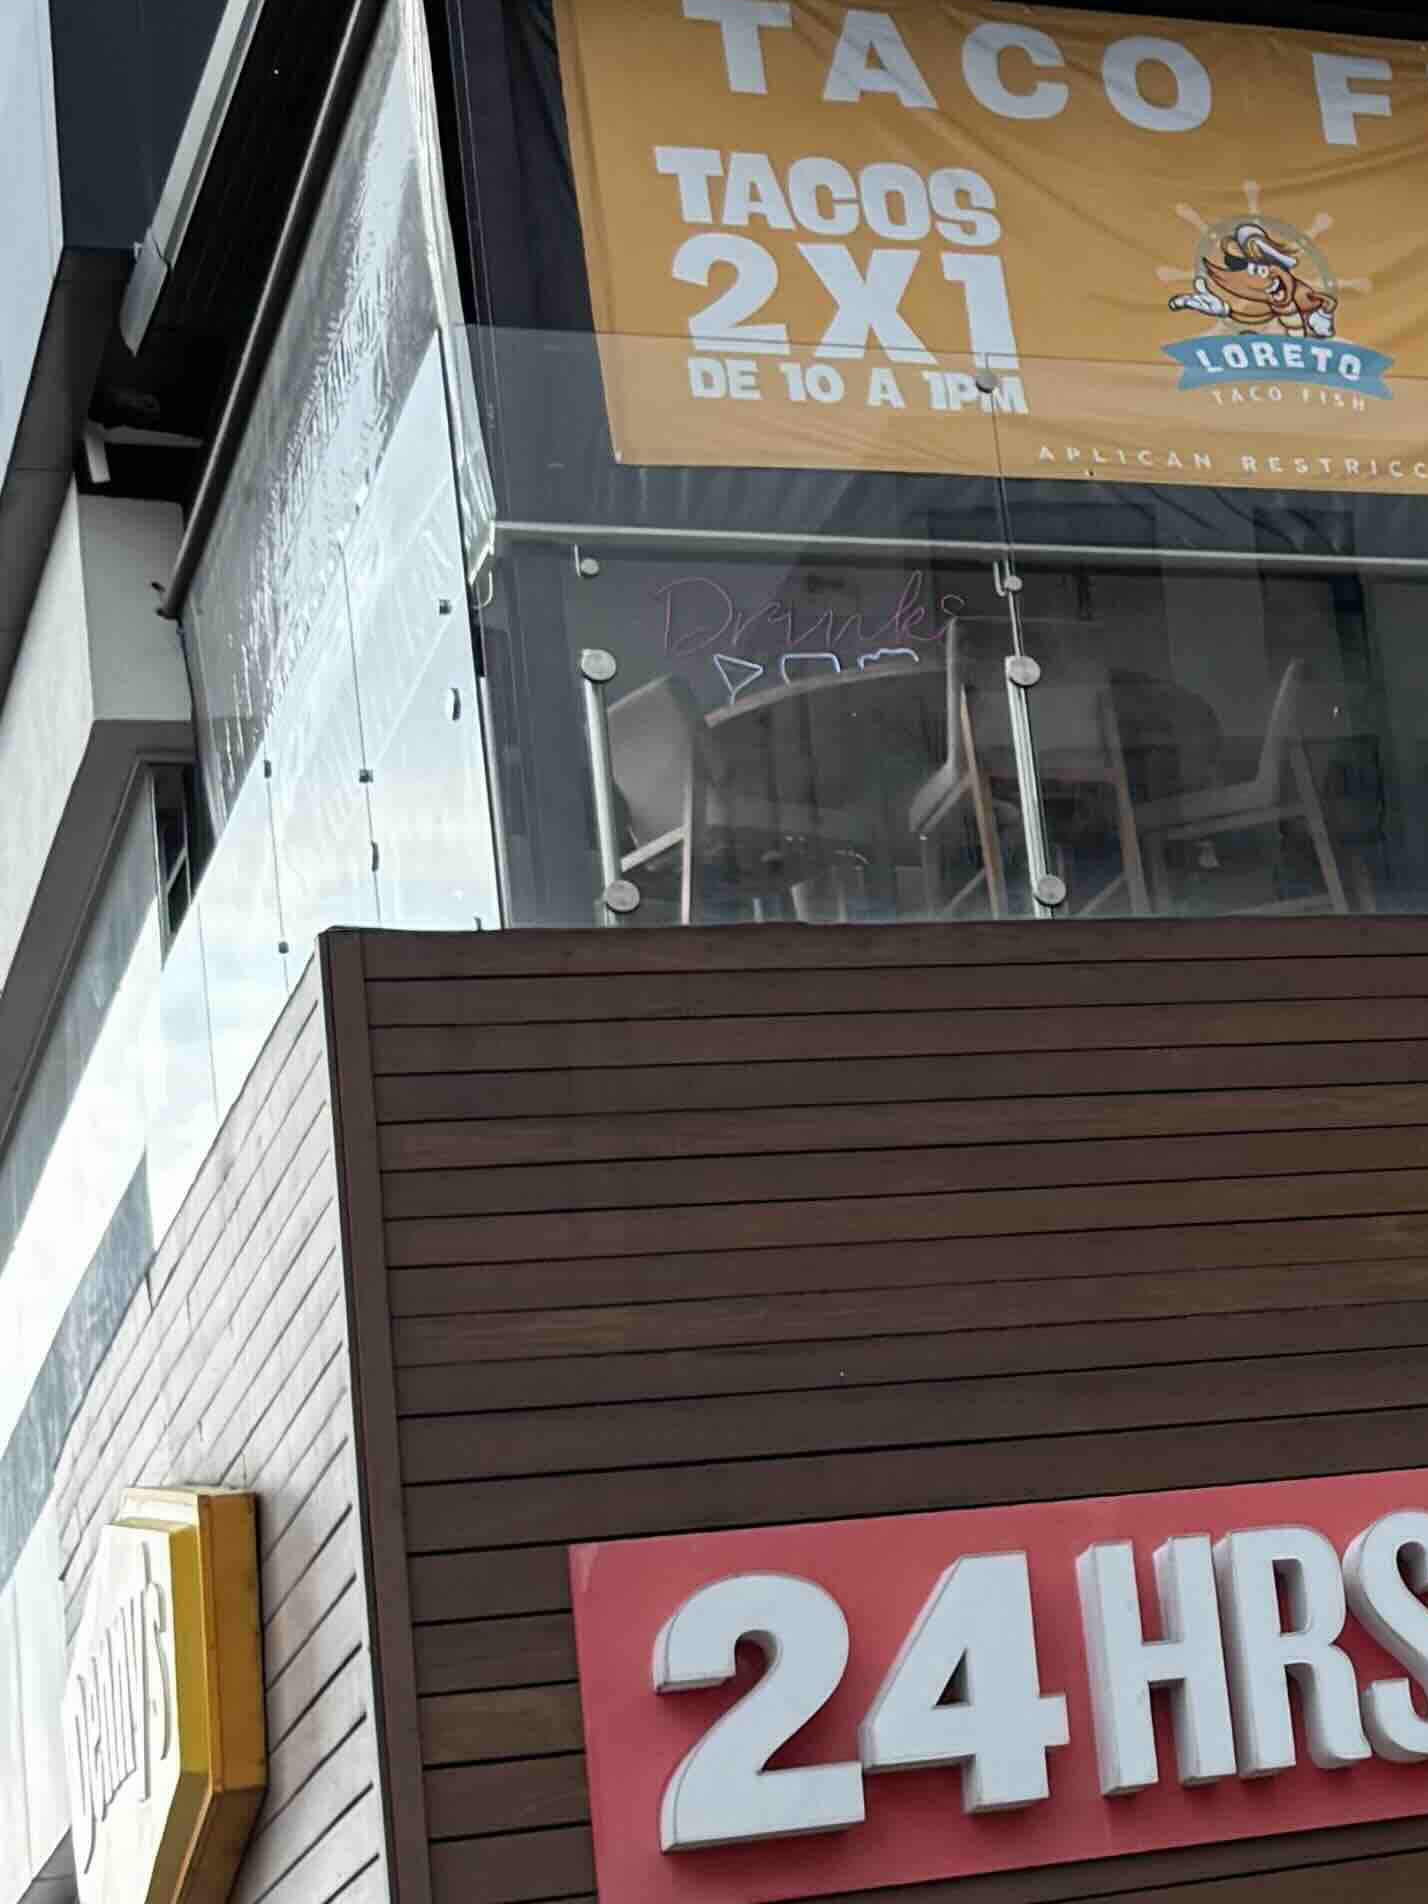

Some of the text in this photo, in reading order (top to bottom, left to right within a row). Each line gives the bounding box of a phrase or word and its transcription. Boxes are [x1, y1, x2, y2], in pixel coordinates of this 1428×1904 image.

[654, 145, 1001, 246] TACOS
[671, 232, 1020, 370] 2X1
[687, 357, 762, 400] DE
[778, 361, 844, 403] 10
[867, 366, 906, 408] A
[1196, 342, 1361, 381] LORETO
[1213, 386, 1365, 412] TACO FISH
[1038, 445, 1212, 470] APLICAN
